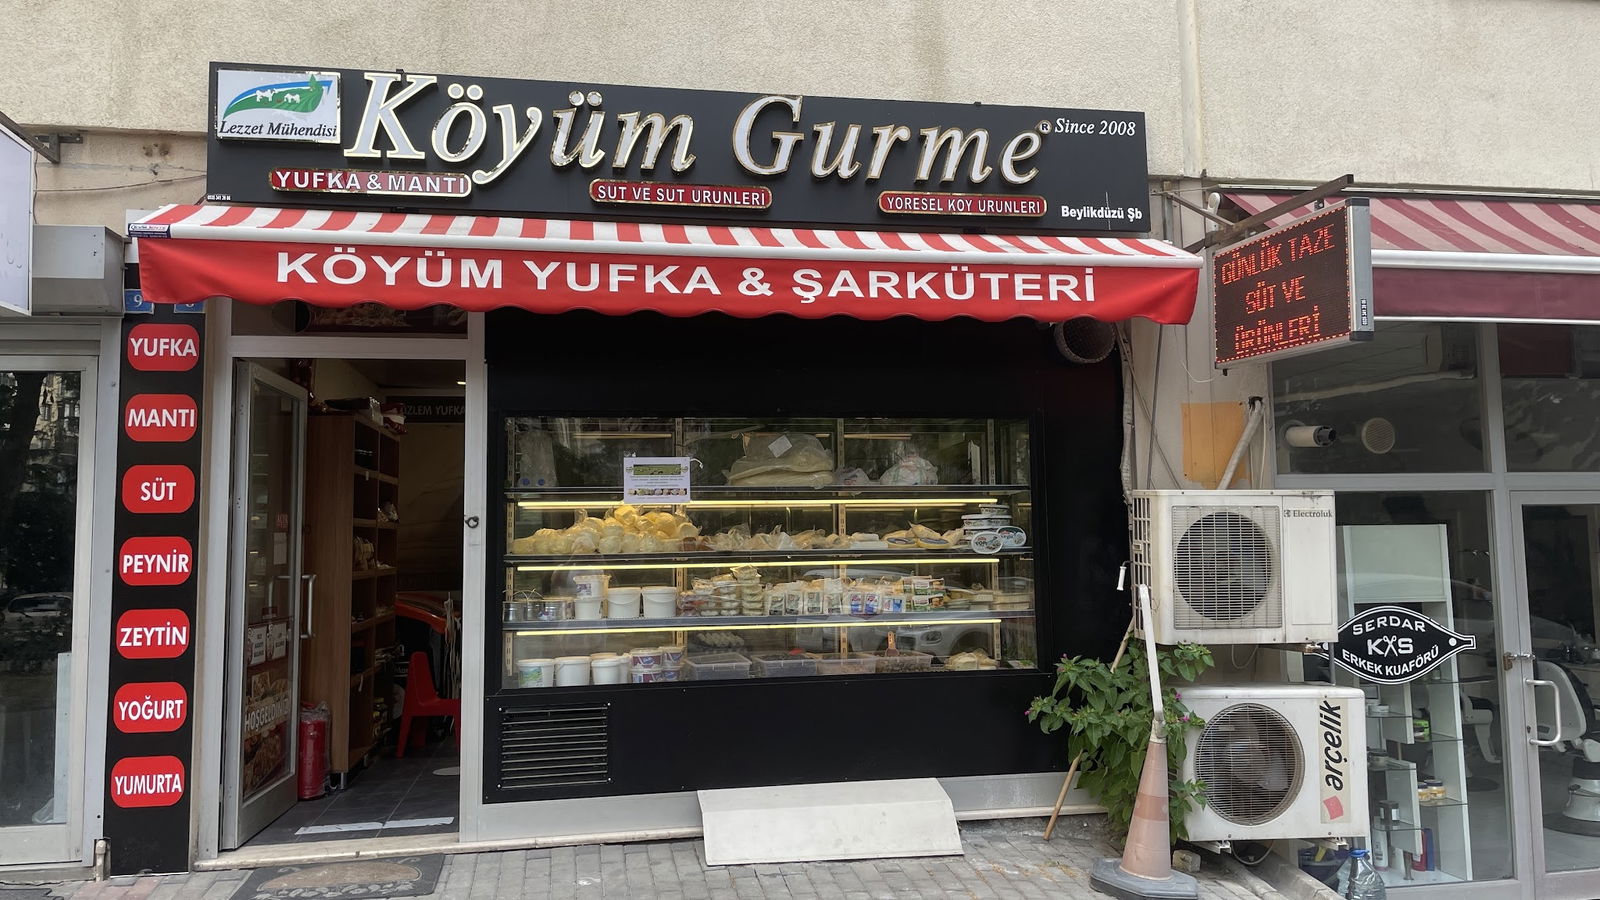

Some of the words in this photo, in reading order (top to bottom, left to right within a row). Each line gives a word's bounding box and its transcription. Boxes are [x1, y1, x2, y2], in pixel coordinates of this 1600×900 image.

[219, 120, 264, 135] Lezzet
[267, 122, 337, 137] Mühendisi
[343, 72, 697, 185] Köyüm
[732, 94, 1042, 185] Gurme
[1055, 118, 1095, 134] Since
[1099, 120, 1136, 136] 2008
[276, 171, 361, 190] YUFKA
[367, 173, 382, 190] &
[388, 174, 464, 193] MANTI
[632, 187, 651, 201] VE
[1061, 205, 1124, 221] Beylikdüzü
[1127, 208, 1143, 222] Şb
[1221, 240, 1283, 285] GÜNLÜK
[1288, 223, 1336, 262] TAZE
[277, 246, 503, 289] KÖYÜM
[523, 260, 721, 295] YUFKA
[737, 267, 774, 297] &
[791, 266, 1095, 304] ŞARKÜTERİ
[133, 294, 143, 308] 9
[1245, 280, 1277, 315] SÜT
[1281, 275, 1306, 303] VE
[1234, 305, 1321, 355] ÜRÜNLERİ
[130, 337, 197, 357] YUFKA
[127, 408, 195, 427] MANTI
[140, 477, 177, 502] SÜT
[122, 549, 189, 574] PEYNİR
[120, 621, 187, 647] ZEYTİN
[1352, 615, 1426, 636] SERDAR
[1342, 648, 1383, 675] ERKEK
[1385, 644, 1440, 677] KUAFÖRÜ
[118, 695, 184, 721] YOĞURT
[1319, 700, 1348, 792] arçelik
[114, 773, 183, 796] YUMURTA
